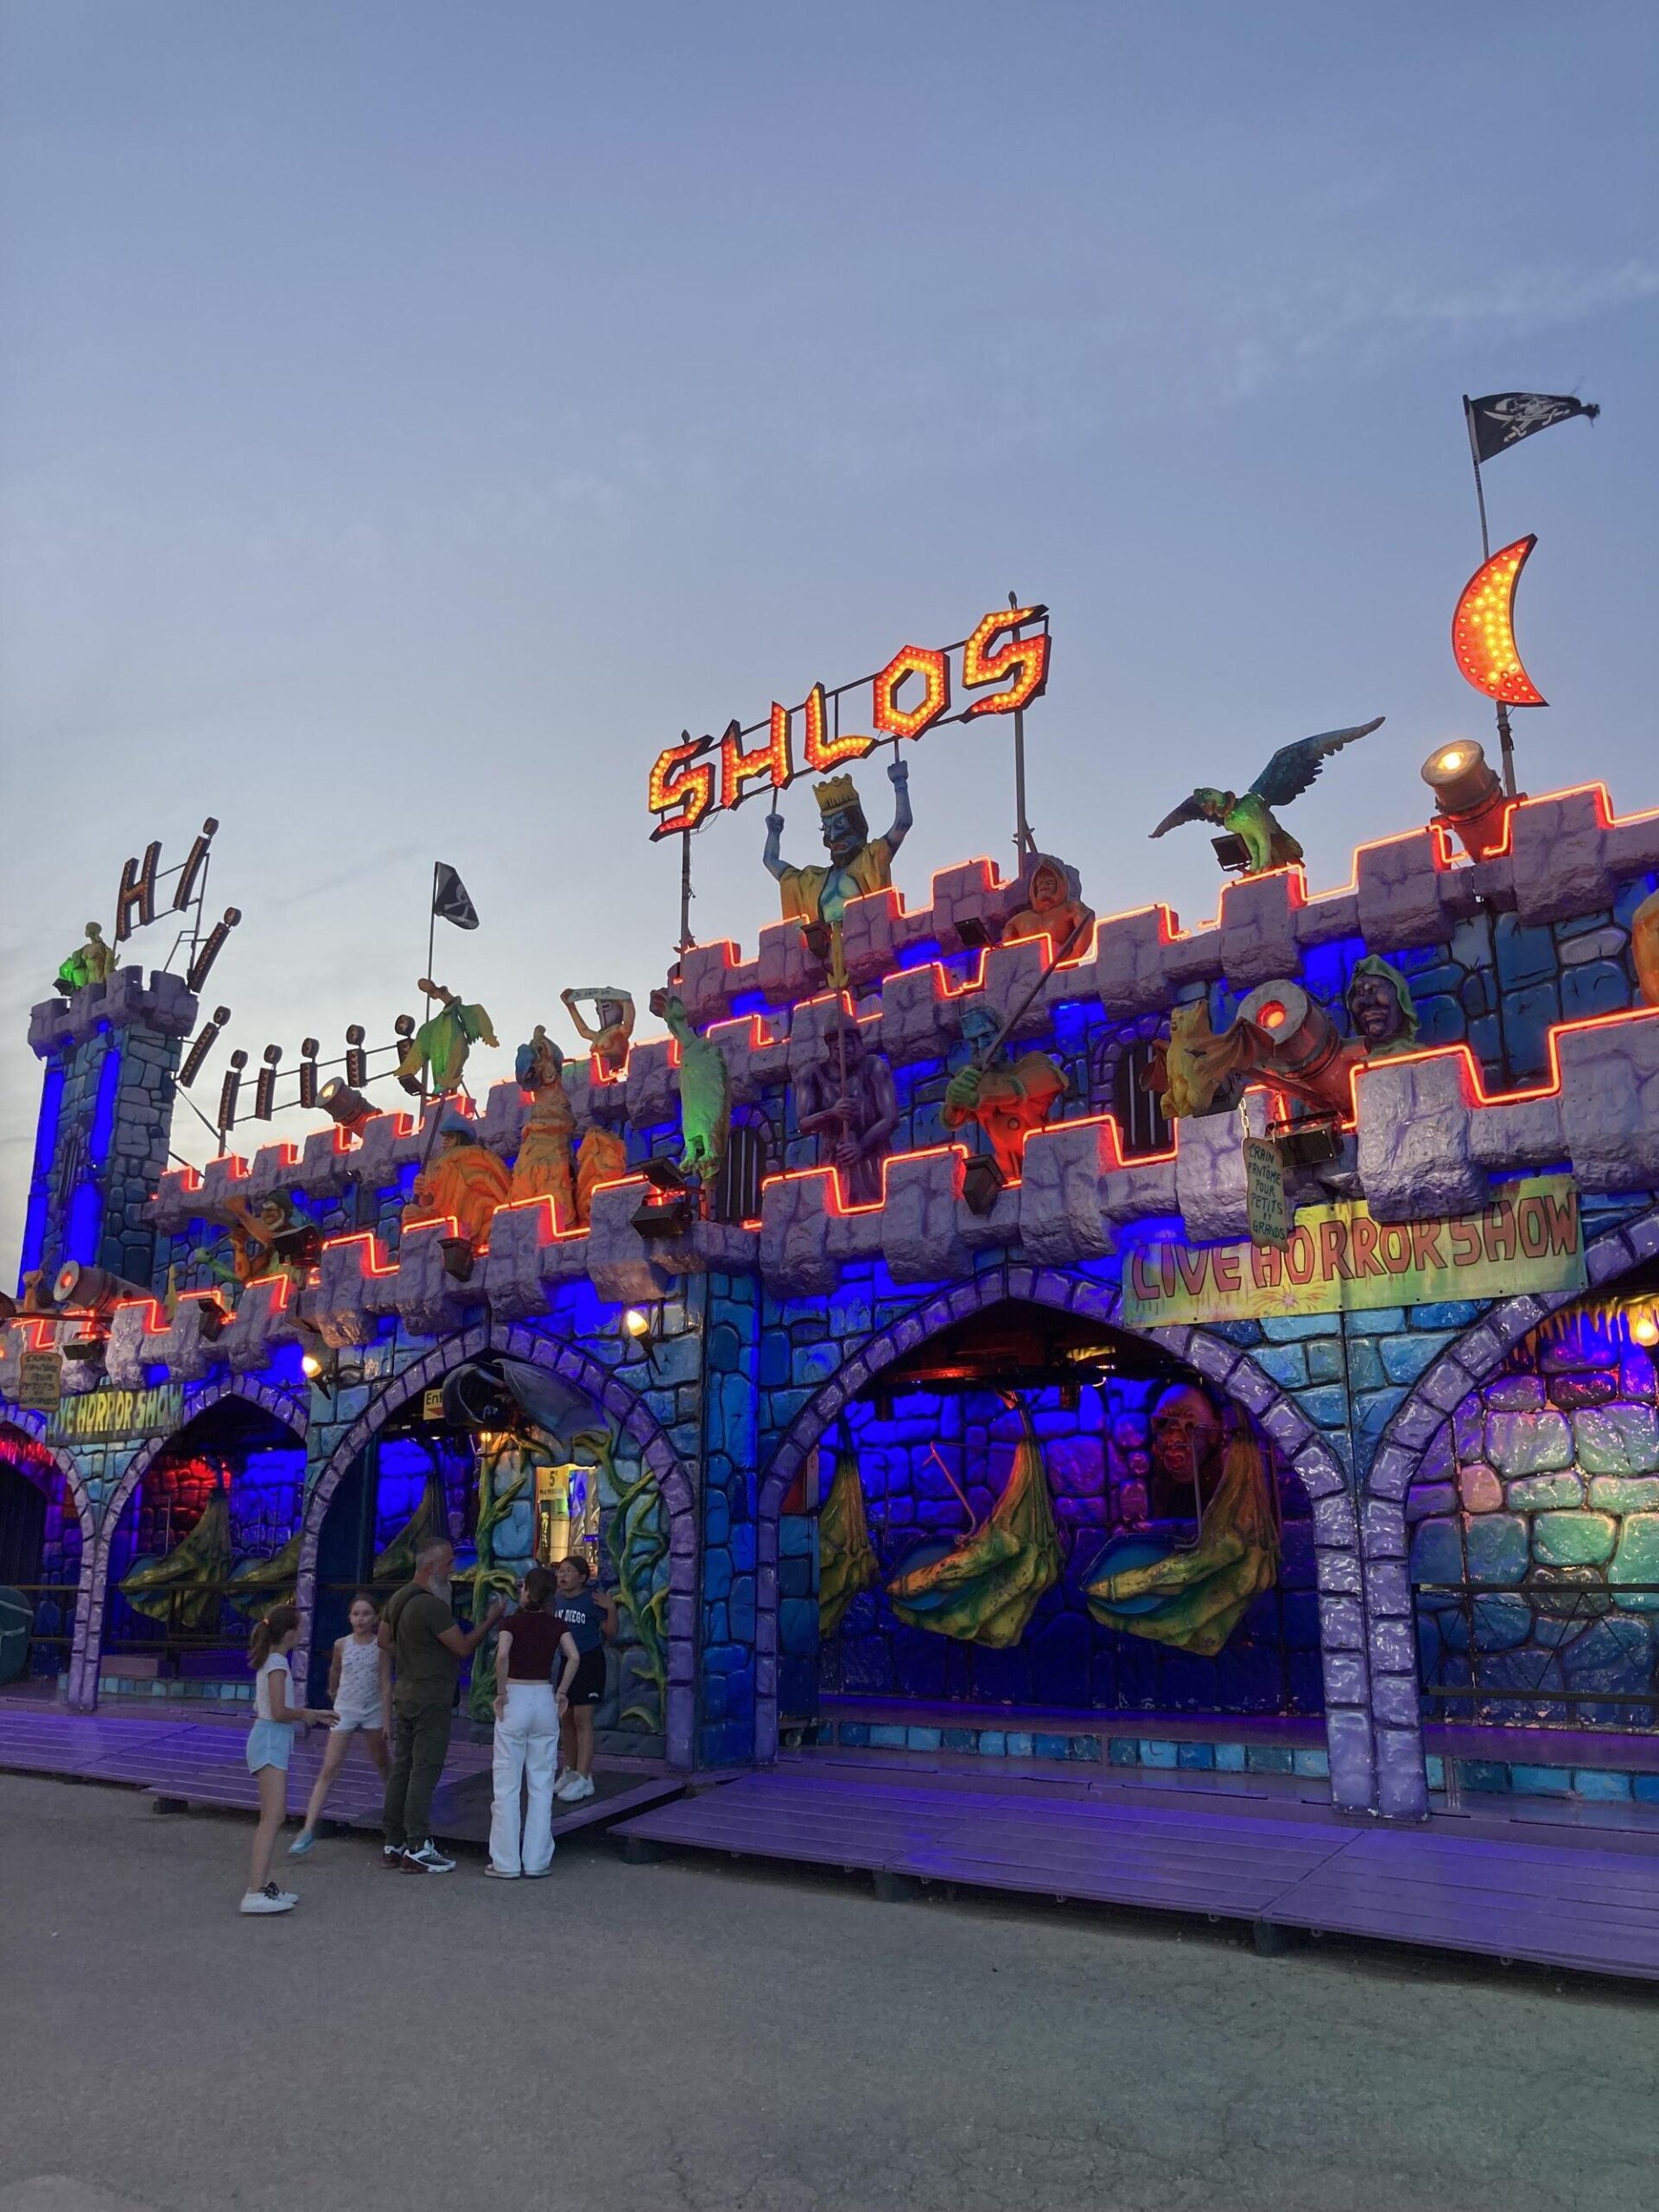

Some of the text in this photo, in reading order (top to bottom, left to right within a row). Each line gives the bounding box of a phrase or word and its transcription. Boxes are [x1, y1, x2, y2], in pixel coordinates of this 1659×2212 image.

[649, 605, 1052, 842] SHLOS
[1255, 1179, 1275, 1198] POUR
[1251, 1192, 1283, 1215] PETITS
[1253, 1220, 1286, 1241] GRANDS
[1132, 1192, 1578, 1300] LIVE HORROR SHOW
[134, 1382, 184, 1430] SHOW
[564, 1610, 586, 1624] DIEGO
